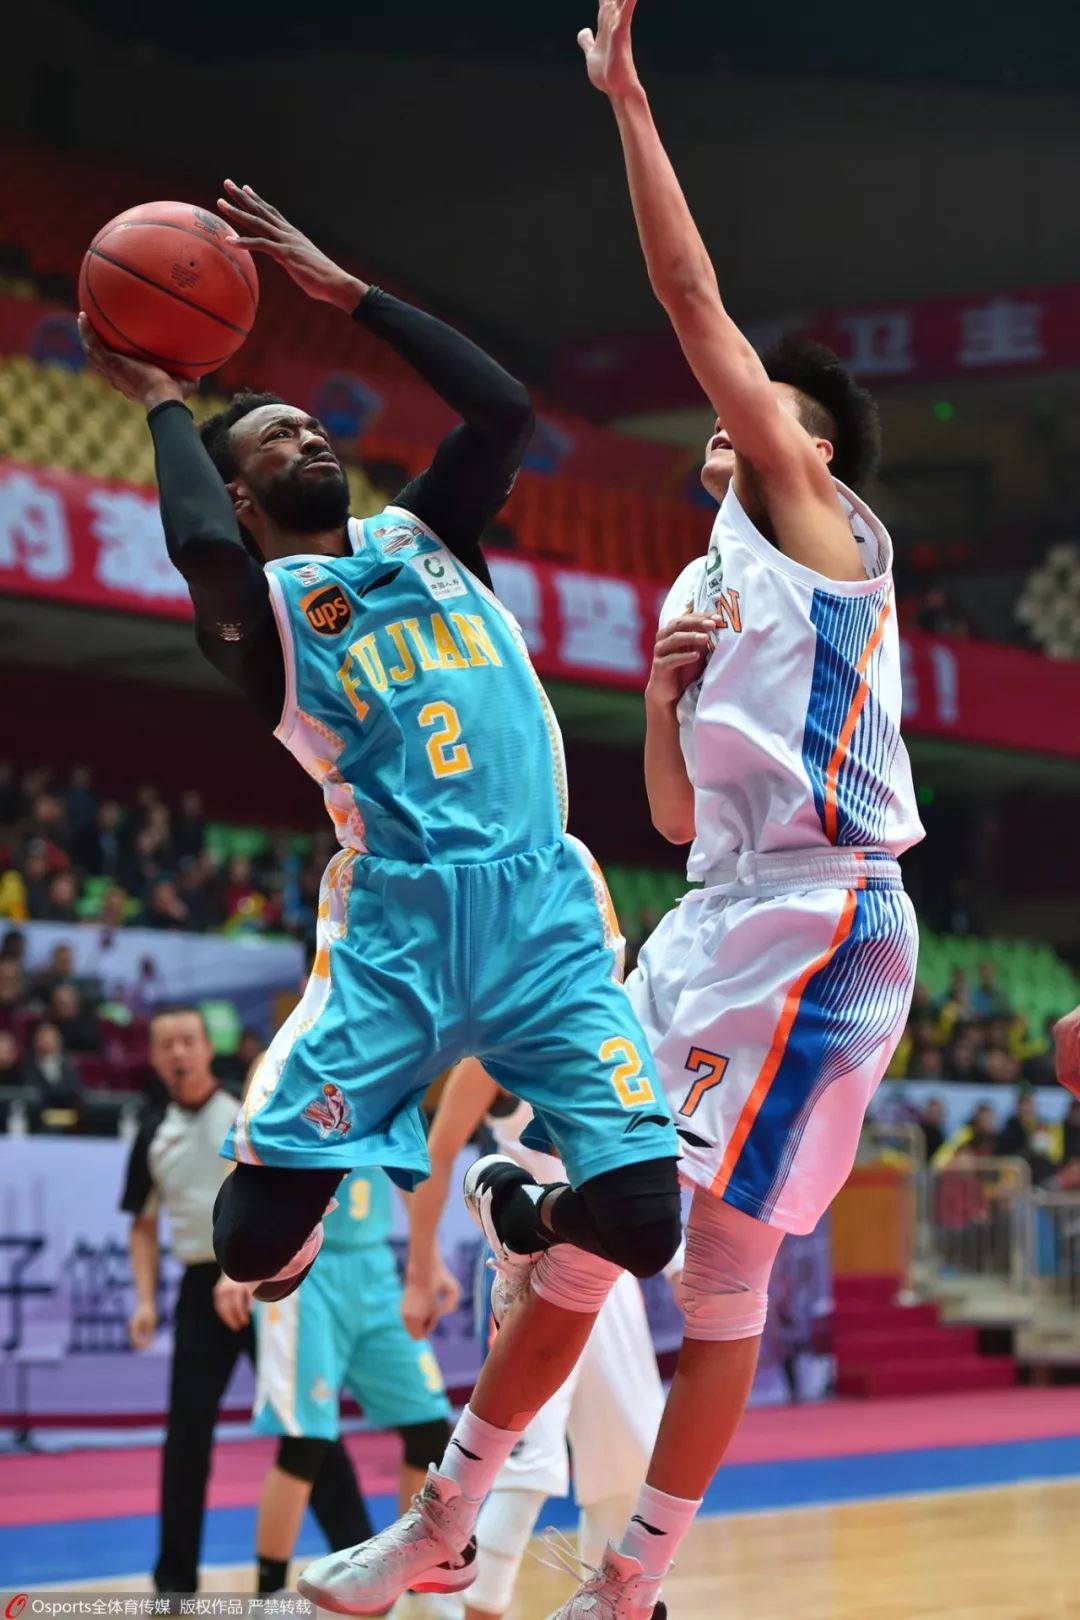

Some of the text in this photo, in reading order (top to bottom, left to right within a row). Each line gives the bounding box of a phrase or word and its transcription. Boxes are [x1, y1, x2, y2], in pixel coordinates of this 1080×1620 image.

[308, 597, 348, 630] ups
[336, 612, 503, 722] FUJIAN
[417, 700, 473, 779] 2
[598, 1036, 656, 1111] 2
[679, 1046, 730, 1117] 7
[350, 1179, 370, 1220] 9
